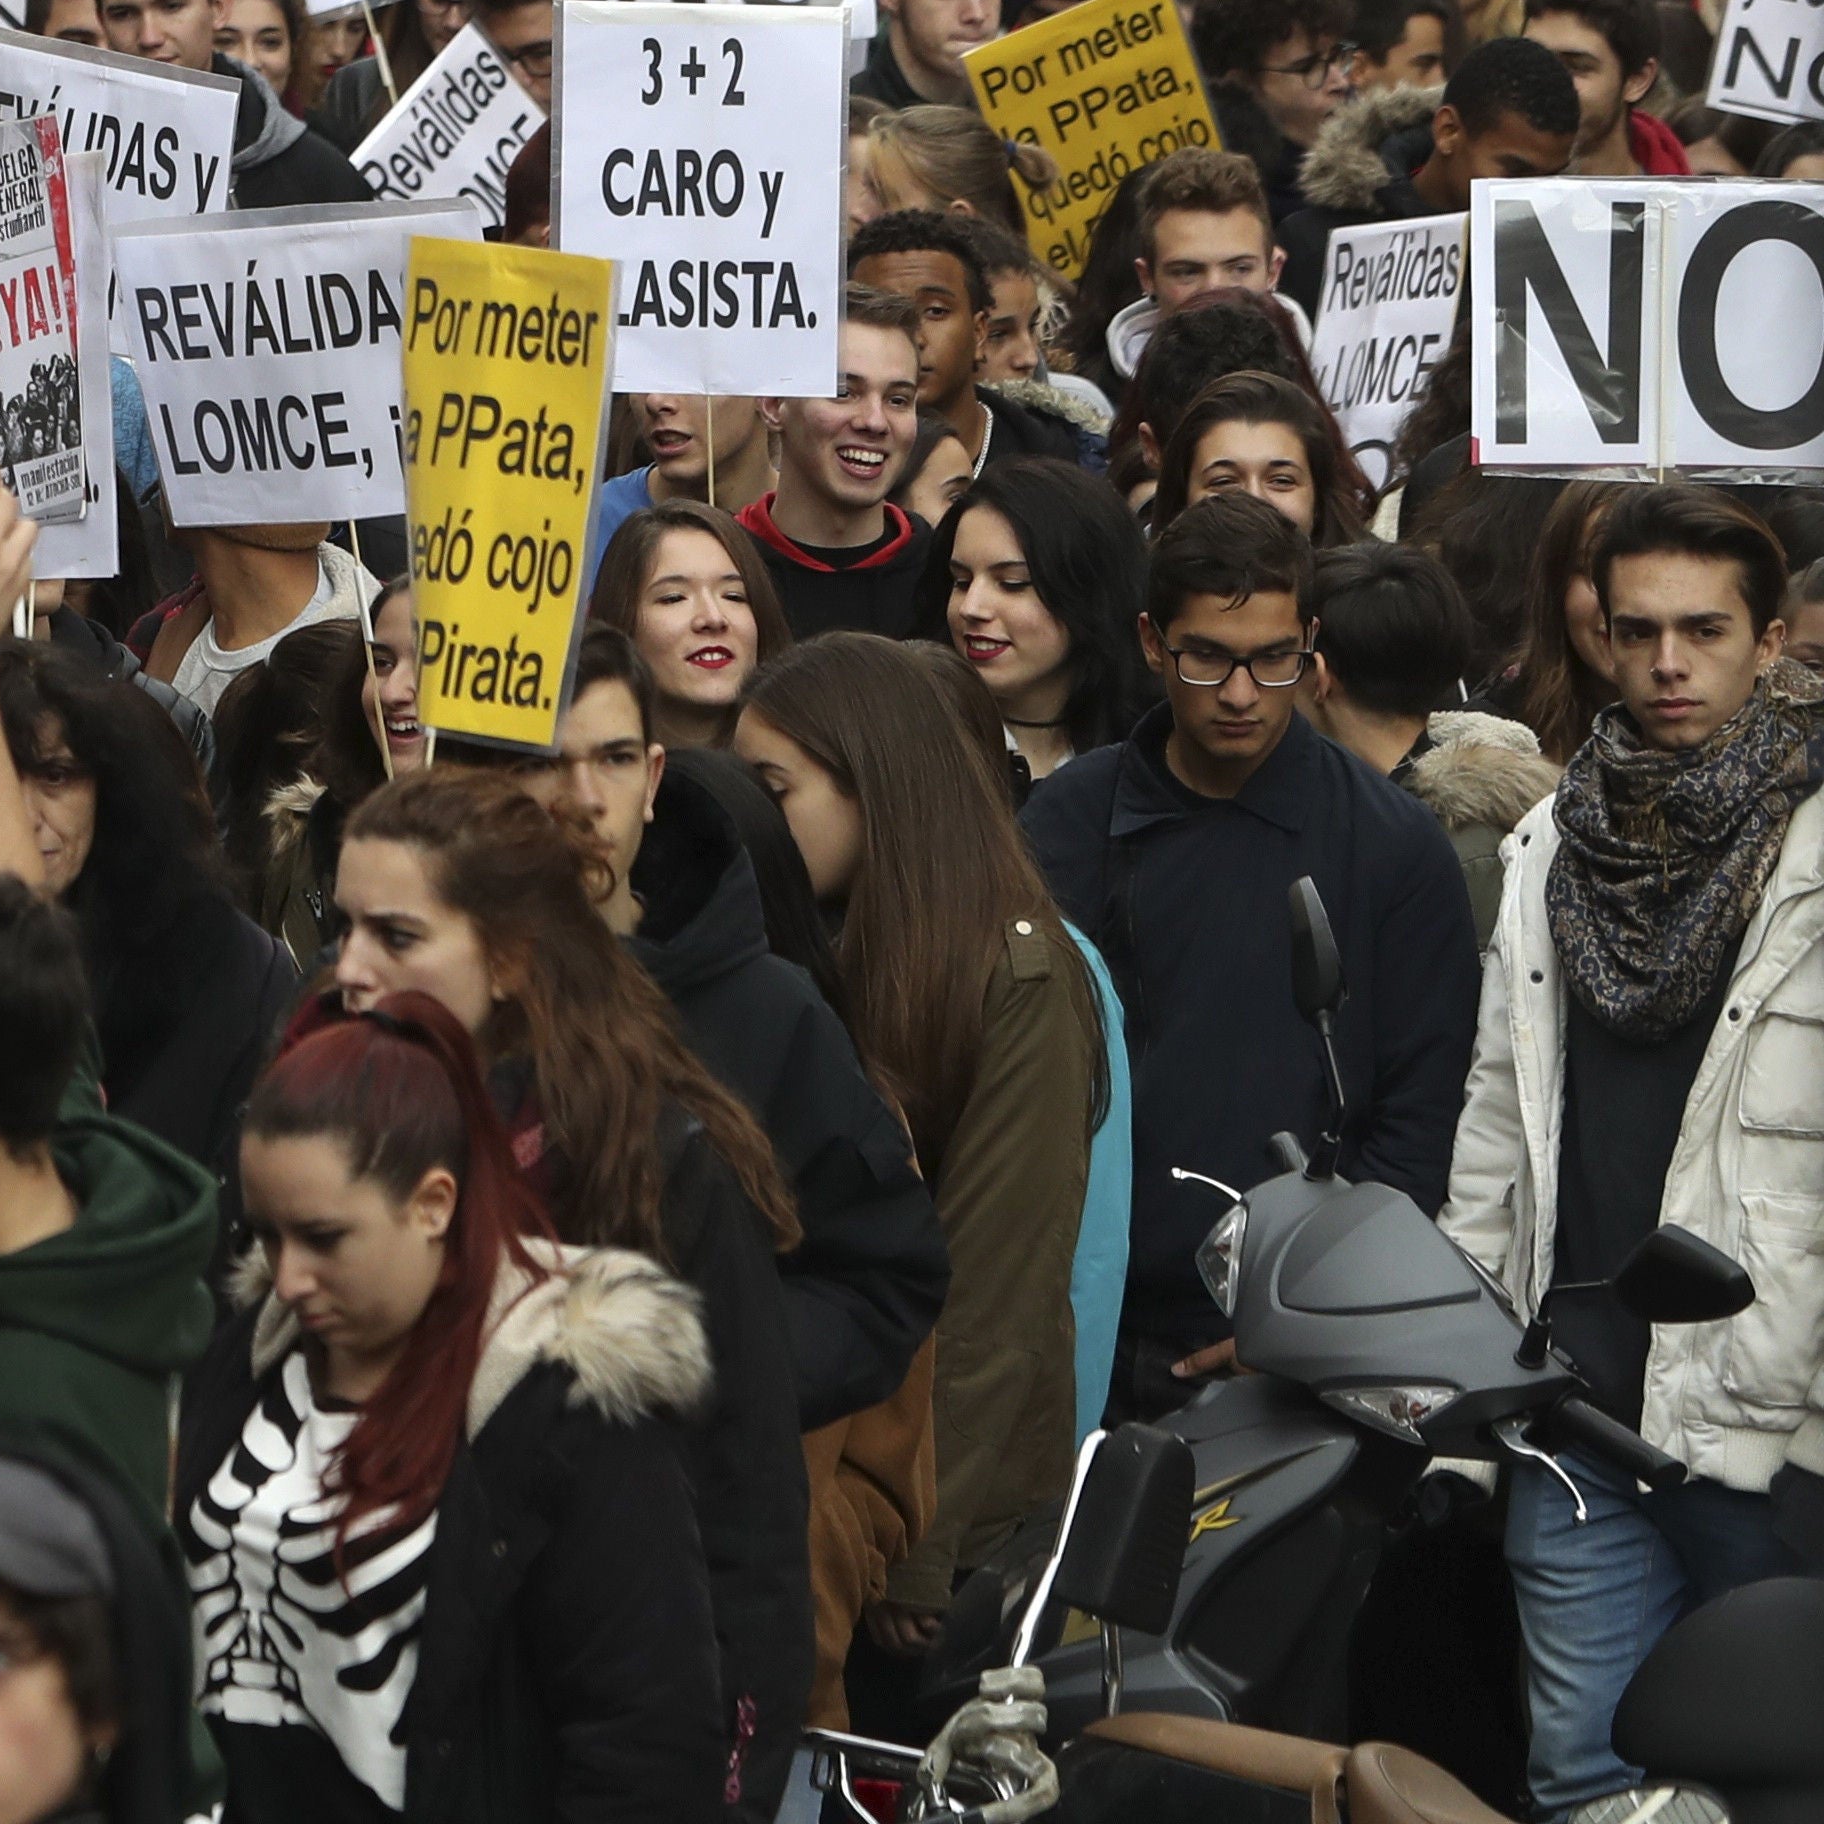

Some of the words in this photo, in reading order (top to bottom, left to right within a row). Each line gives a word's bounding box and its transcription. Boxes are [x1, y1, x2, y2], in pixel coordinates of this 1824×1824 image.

[640, 37, 662, 106] 3
[721, 36, 747, 107] 2
[979, 53, 1048, 111] Por
[1056, 1, 1165, 77] meter
[602, 148, 745, 218] CARO
[757, 168, 785, 240] y
[1047, 229, 1079, 271] el
[1326, 232, 1461, 316] Reválidas
[407, 276, 477, 349] Por
[479, 292, 600, 370] meter
[1494, 199, 1824, 452] NO
[157, 390, 373, 481] LOMCE,
[429, 390, 586, 497] PPata,
